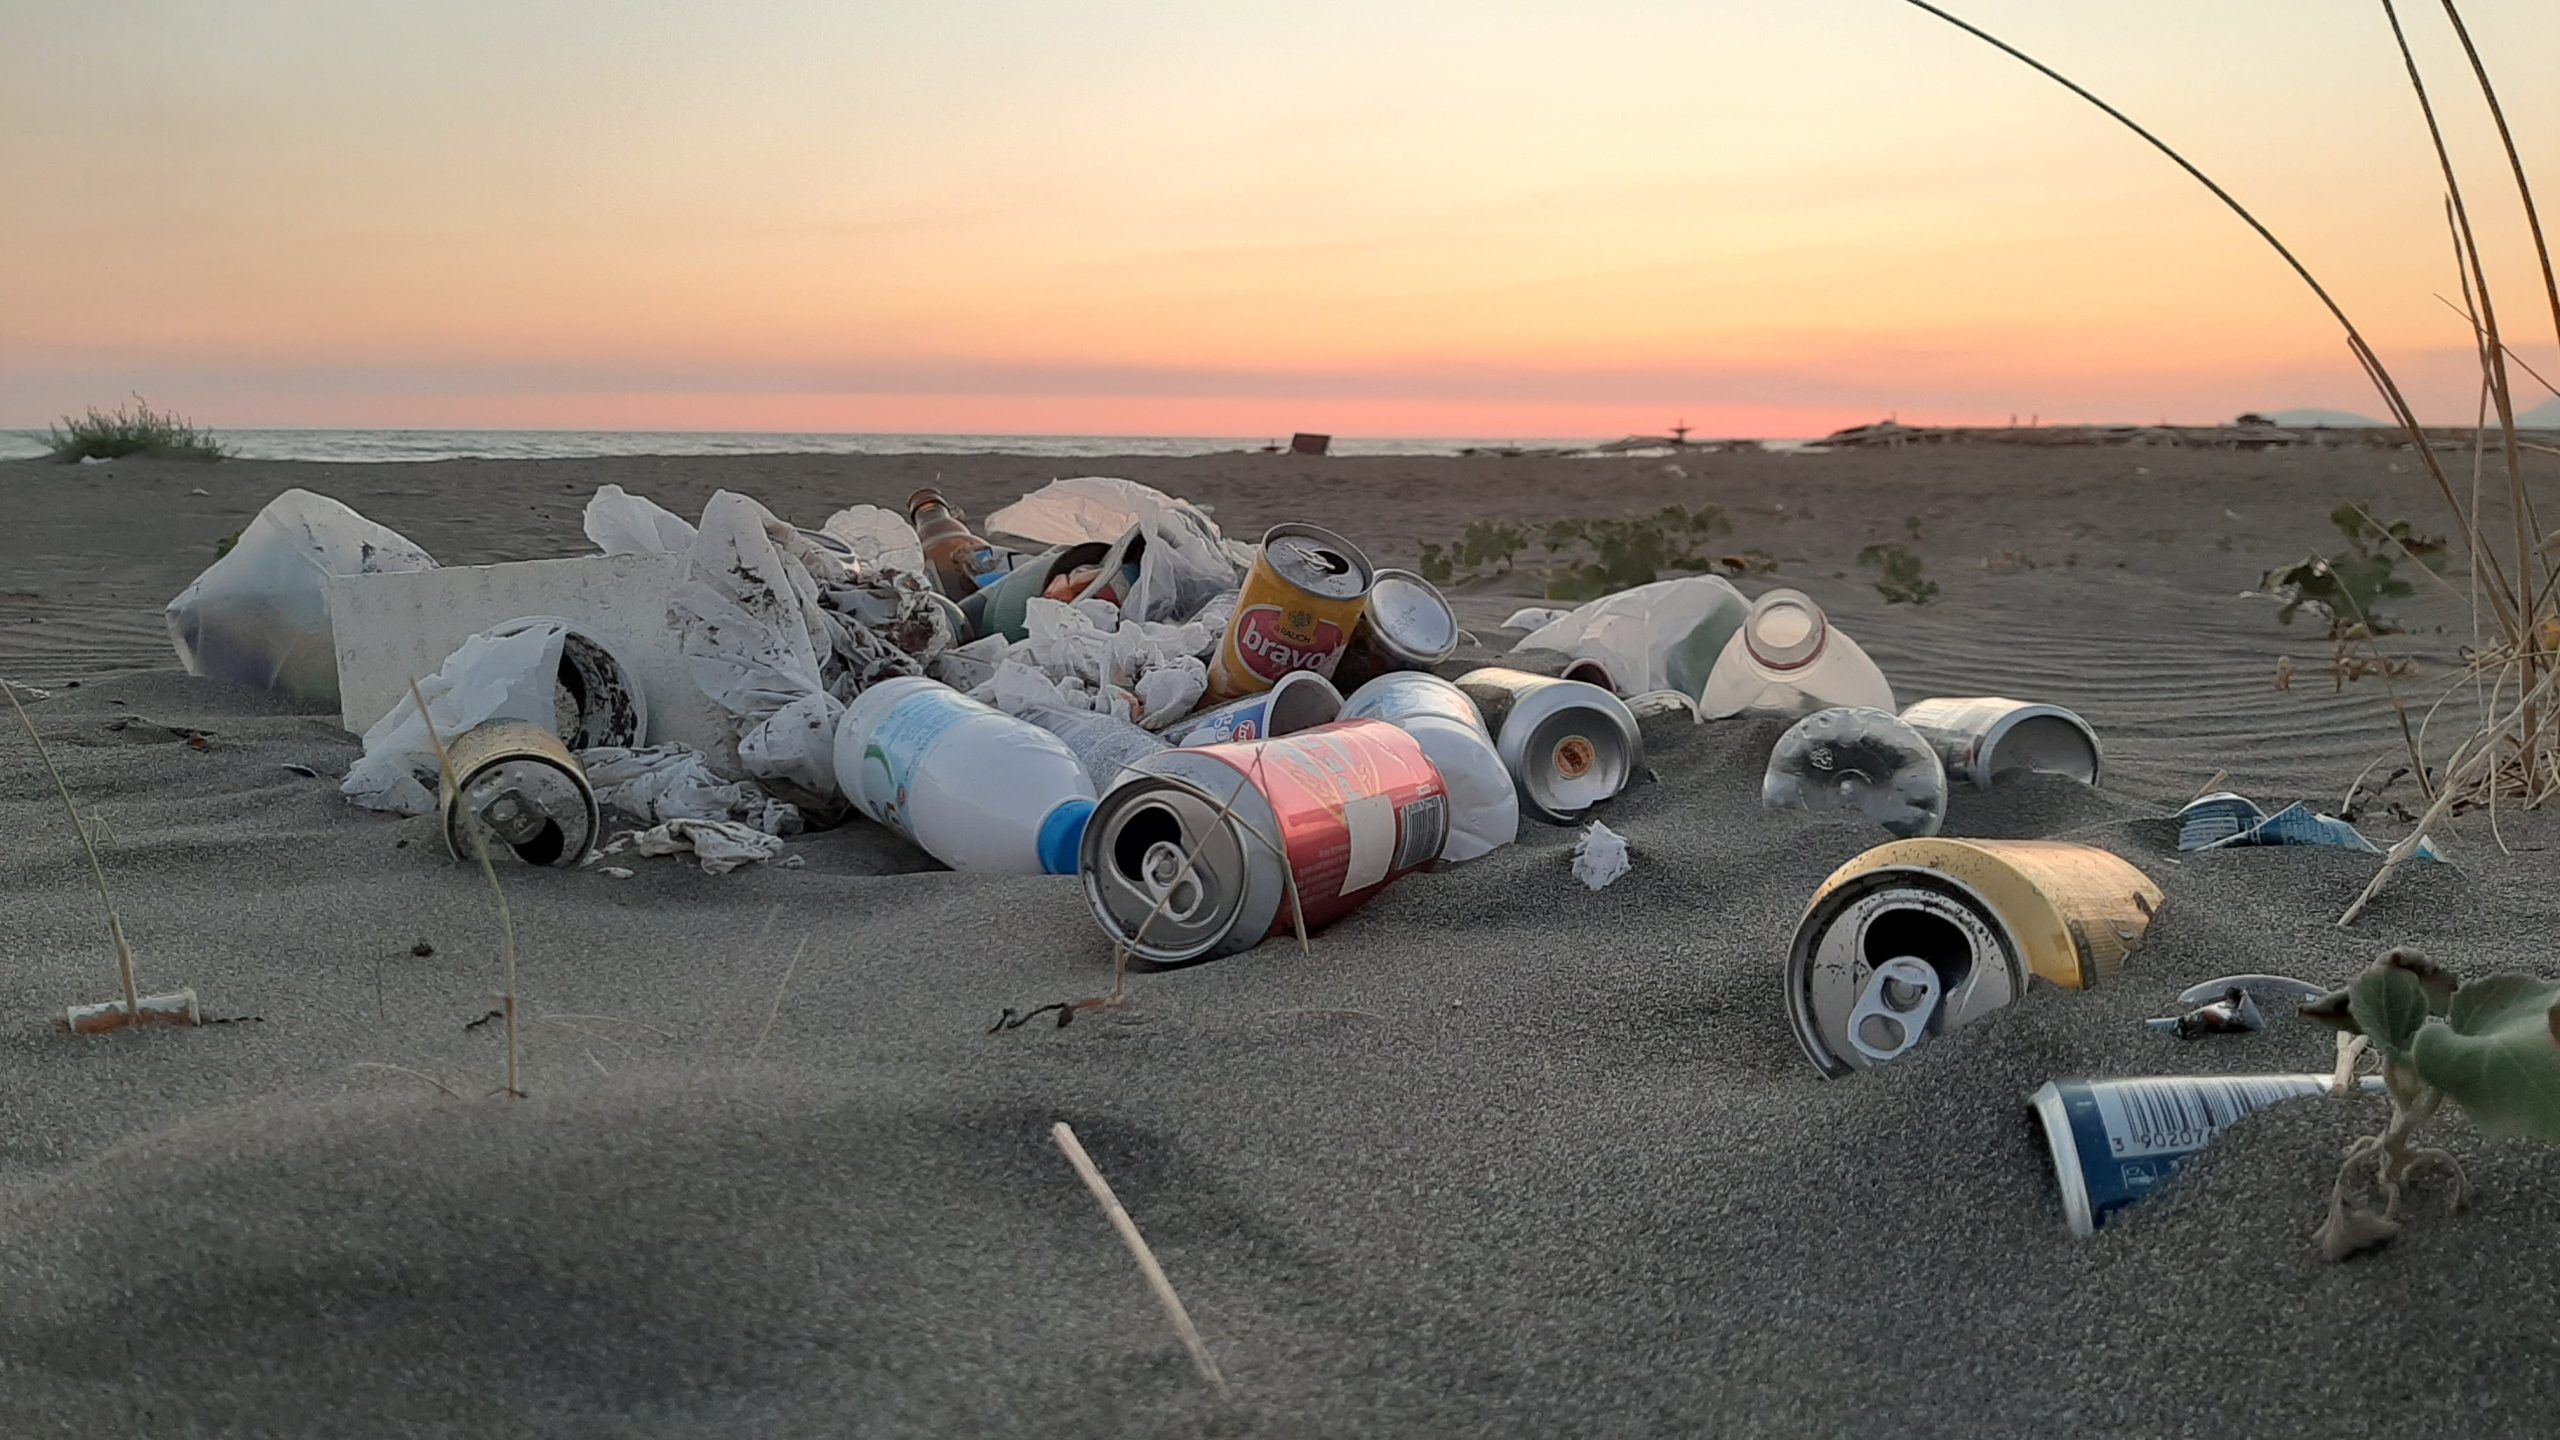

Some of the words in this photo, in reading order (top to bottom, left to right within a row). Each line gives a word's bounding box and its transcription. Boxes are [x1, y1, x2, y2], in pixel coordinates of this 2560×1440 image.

[1242, 617, 1327, 669] bravo
[1281, 627, 1311, 643] RAUCH
[2112, 1137, 2125, 1151] 3
